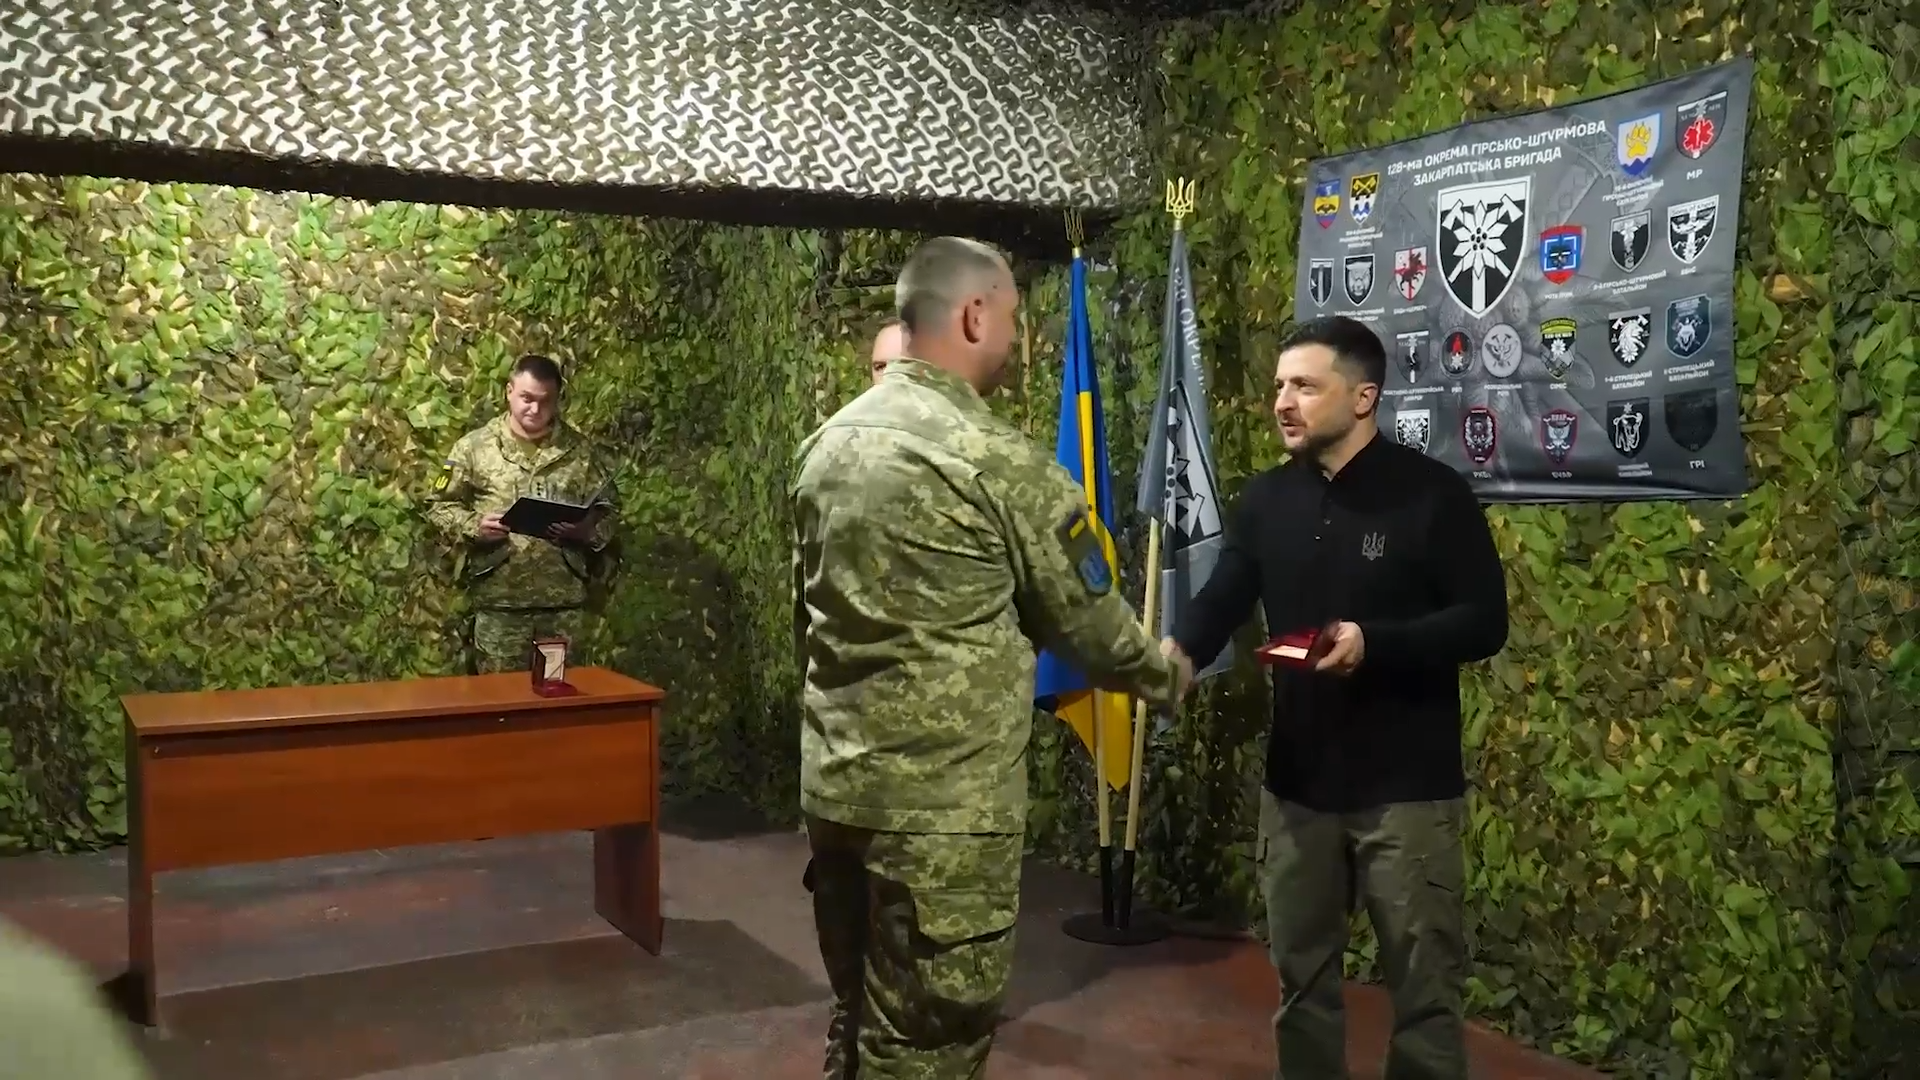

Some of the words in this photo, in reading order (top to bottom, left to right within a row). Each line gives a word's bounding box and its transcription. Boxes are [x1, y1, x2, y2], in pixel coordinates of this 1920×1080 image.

[1387, 160, 1422, 176] 128-ма
[1424, 144, 1469, 168] ОКРЕМА
[1471, 120, 1607, 157] ГІРСЬКО-ШТУРМОВА
[1413, 157, 1502, 187] ЗАКАРПАТСЬКА
[1504, 146, 1562, 169] БРИГАДА
